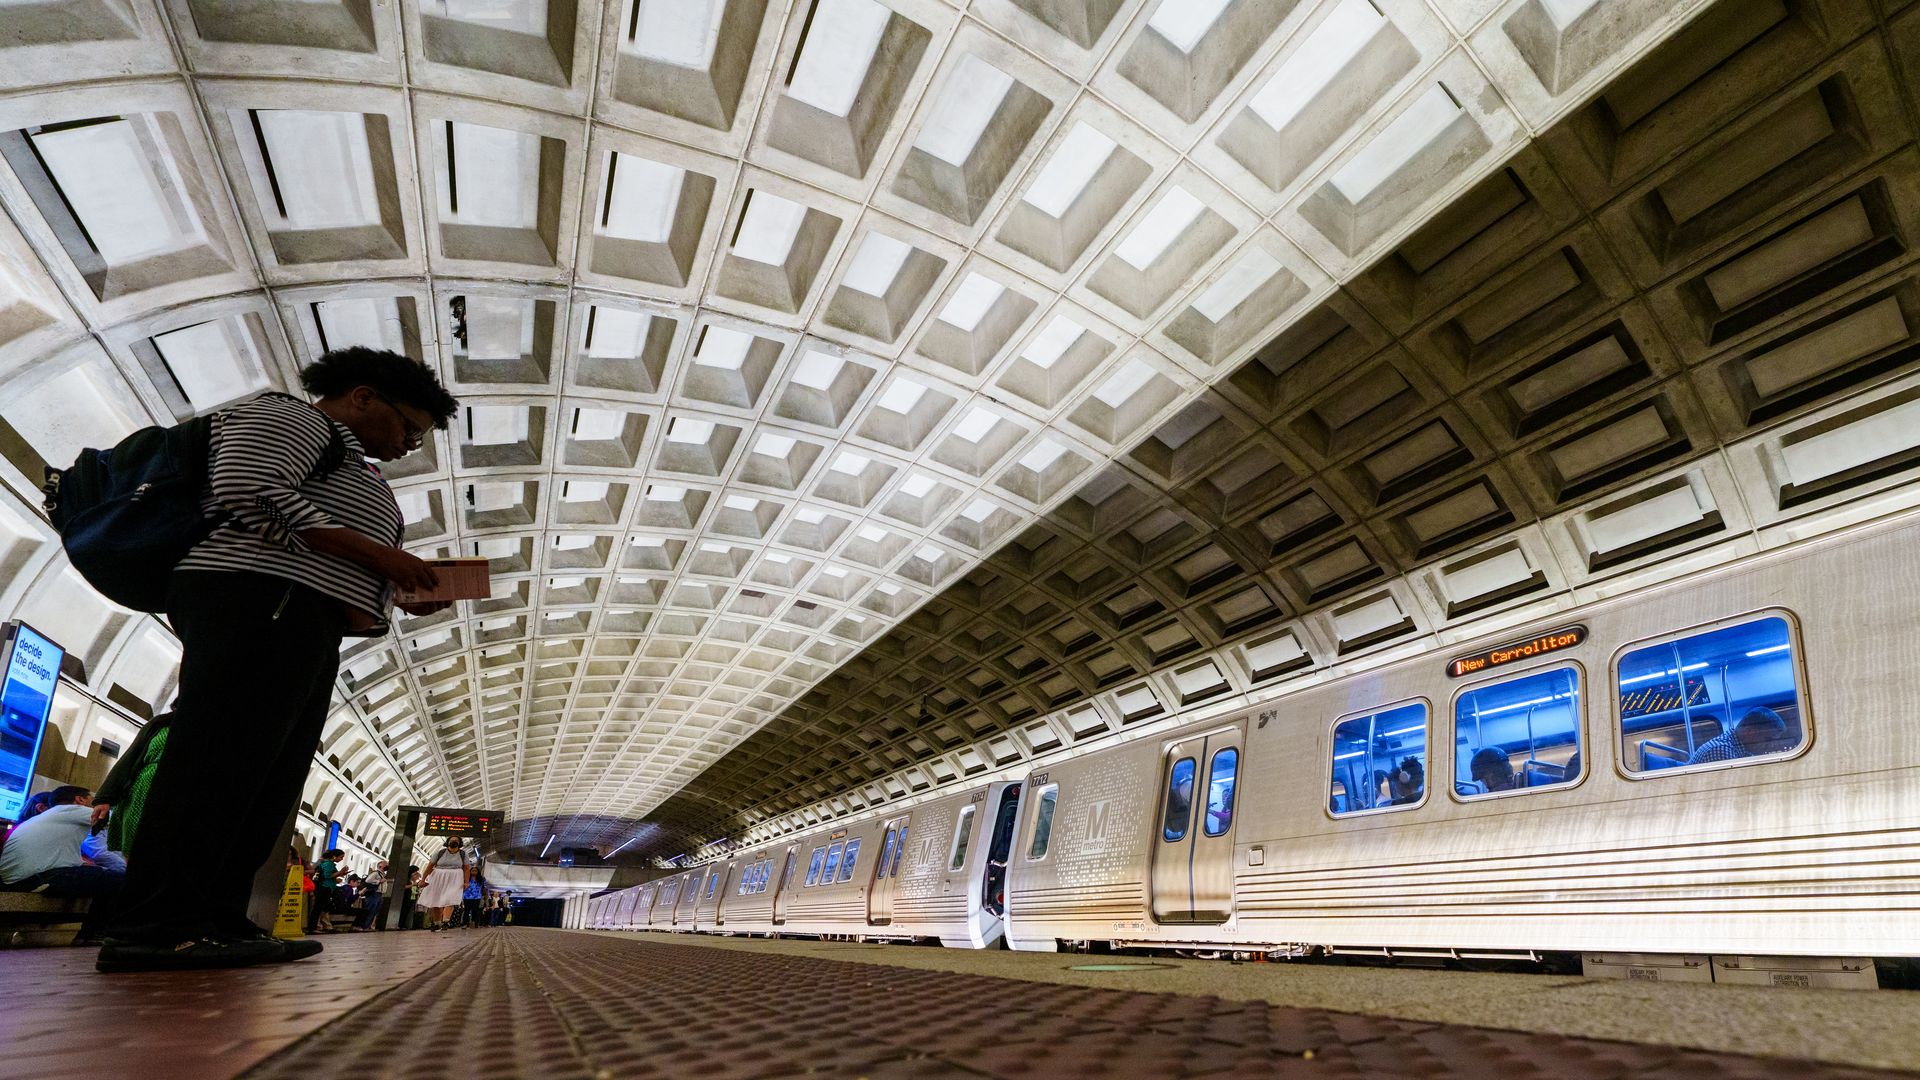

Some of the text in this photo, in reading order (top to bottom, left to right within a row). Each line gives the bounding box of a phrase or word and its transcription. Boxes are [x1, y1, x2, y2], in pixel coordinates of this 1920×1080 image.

[19, 638, 42, 660] decide
[1461, 633, 1577, 673] New Carrollton
[15, 651, 51, 681] the design.
[1032, 775, 1048, 787] 7712
[1084, 802, 1111, 841] M
[918, 839, 933, 865] M
[1083, 840, 1104, 850] metro
